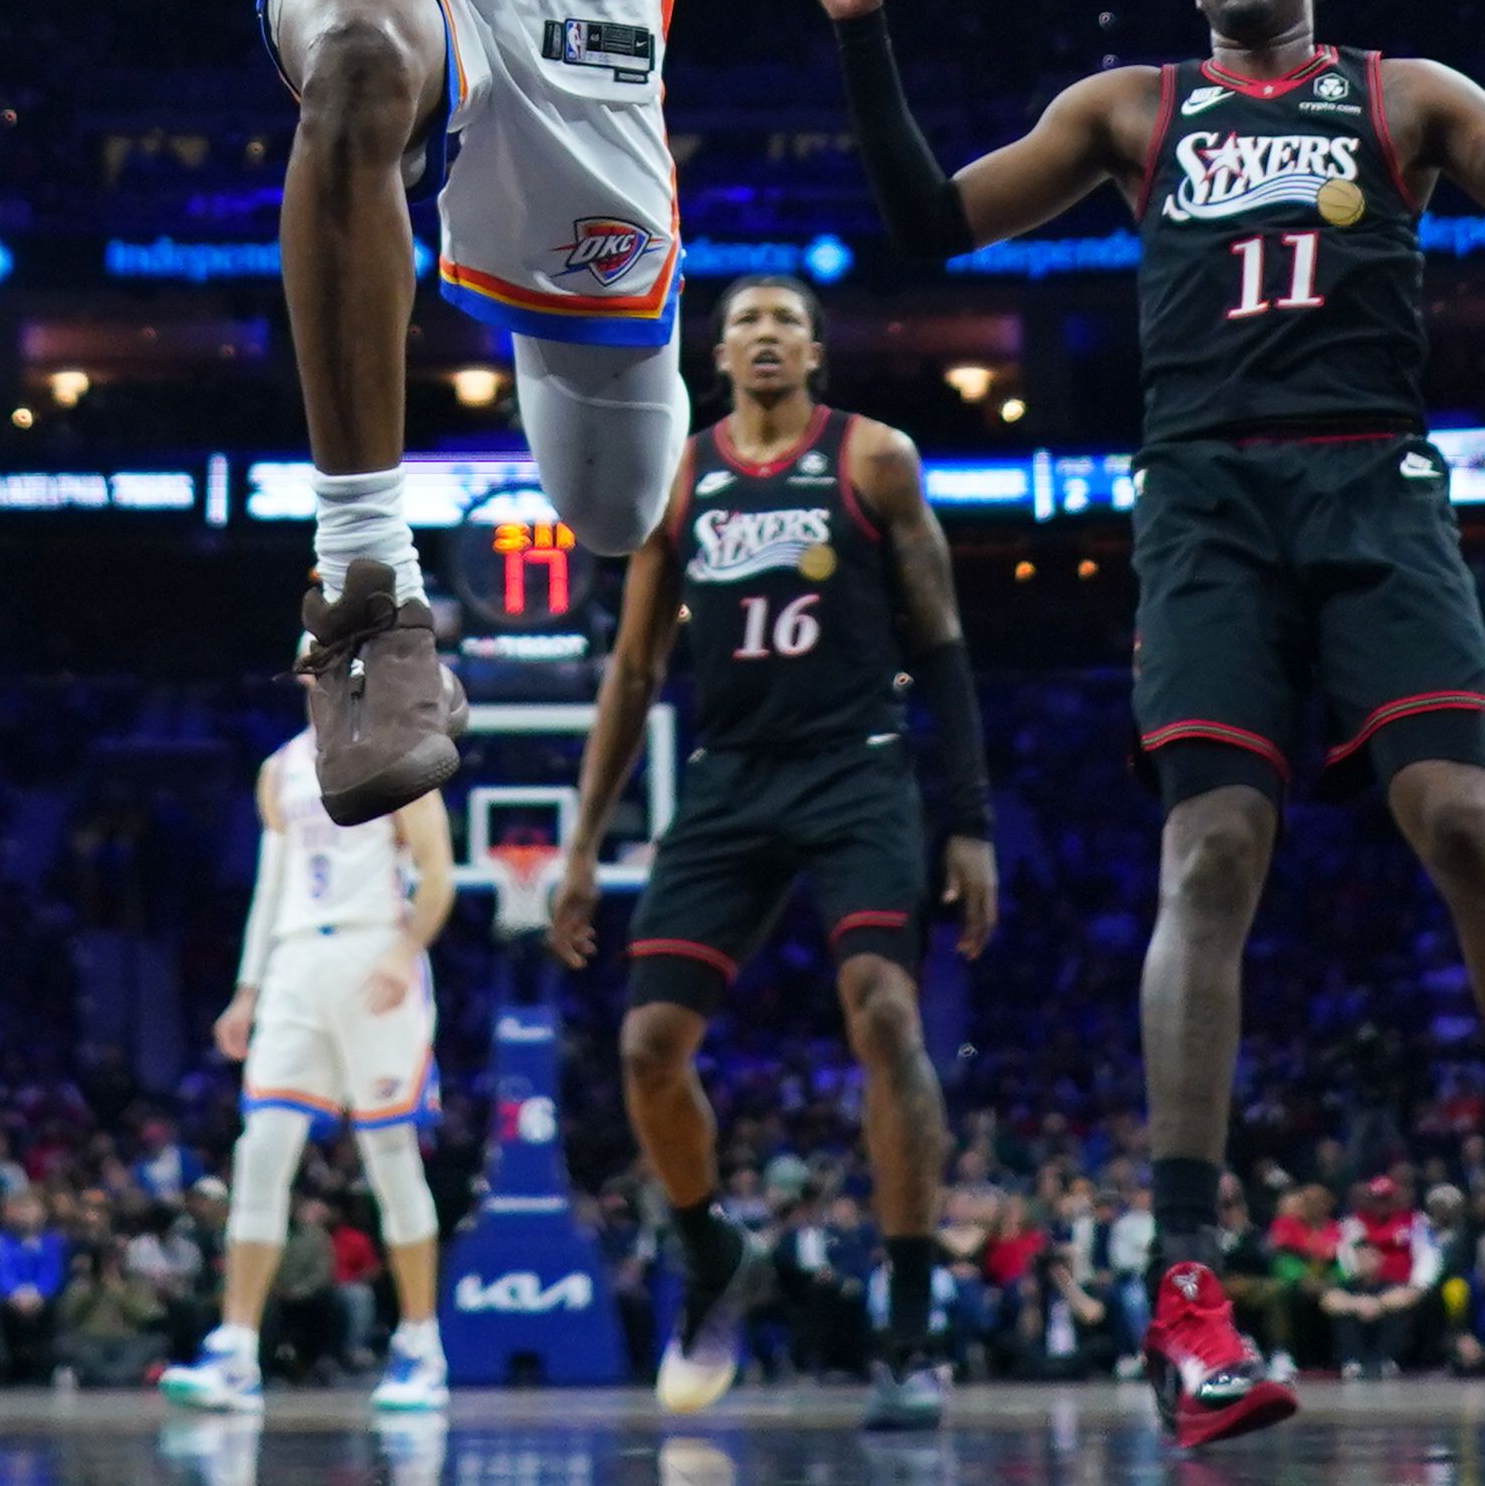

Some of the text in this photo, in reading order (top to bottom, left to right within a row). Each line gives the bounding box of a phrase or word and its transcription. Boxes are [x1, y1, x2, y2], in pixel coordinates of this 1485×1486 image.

[1298, 101, 1362, 116] crypto.com
[571, 233, 635, 263] OKC
[1226, 230, 1325, 320] 11
[731, 592, 822, 660] 16
